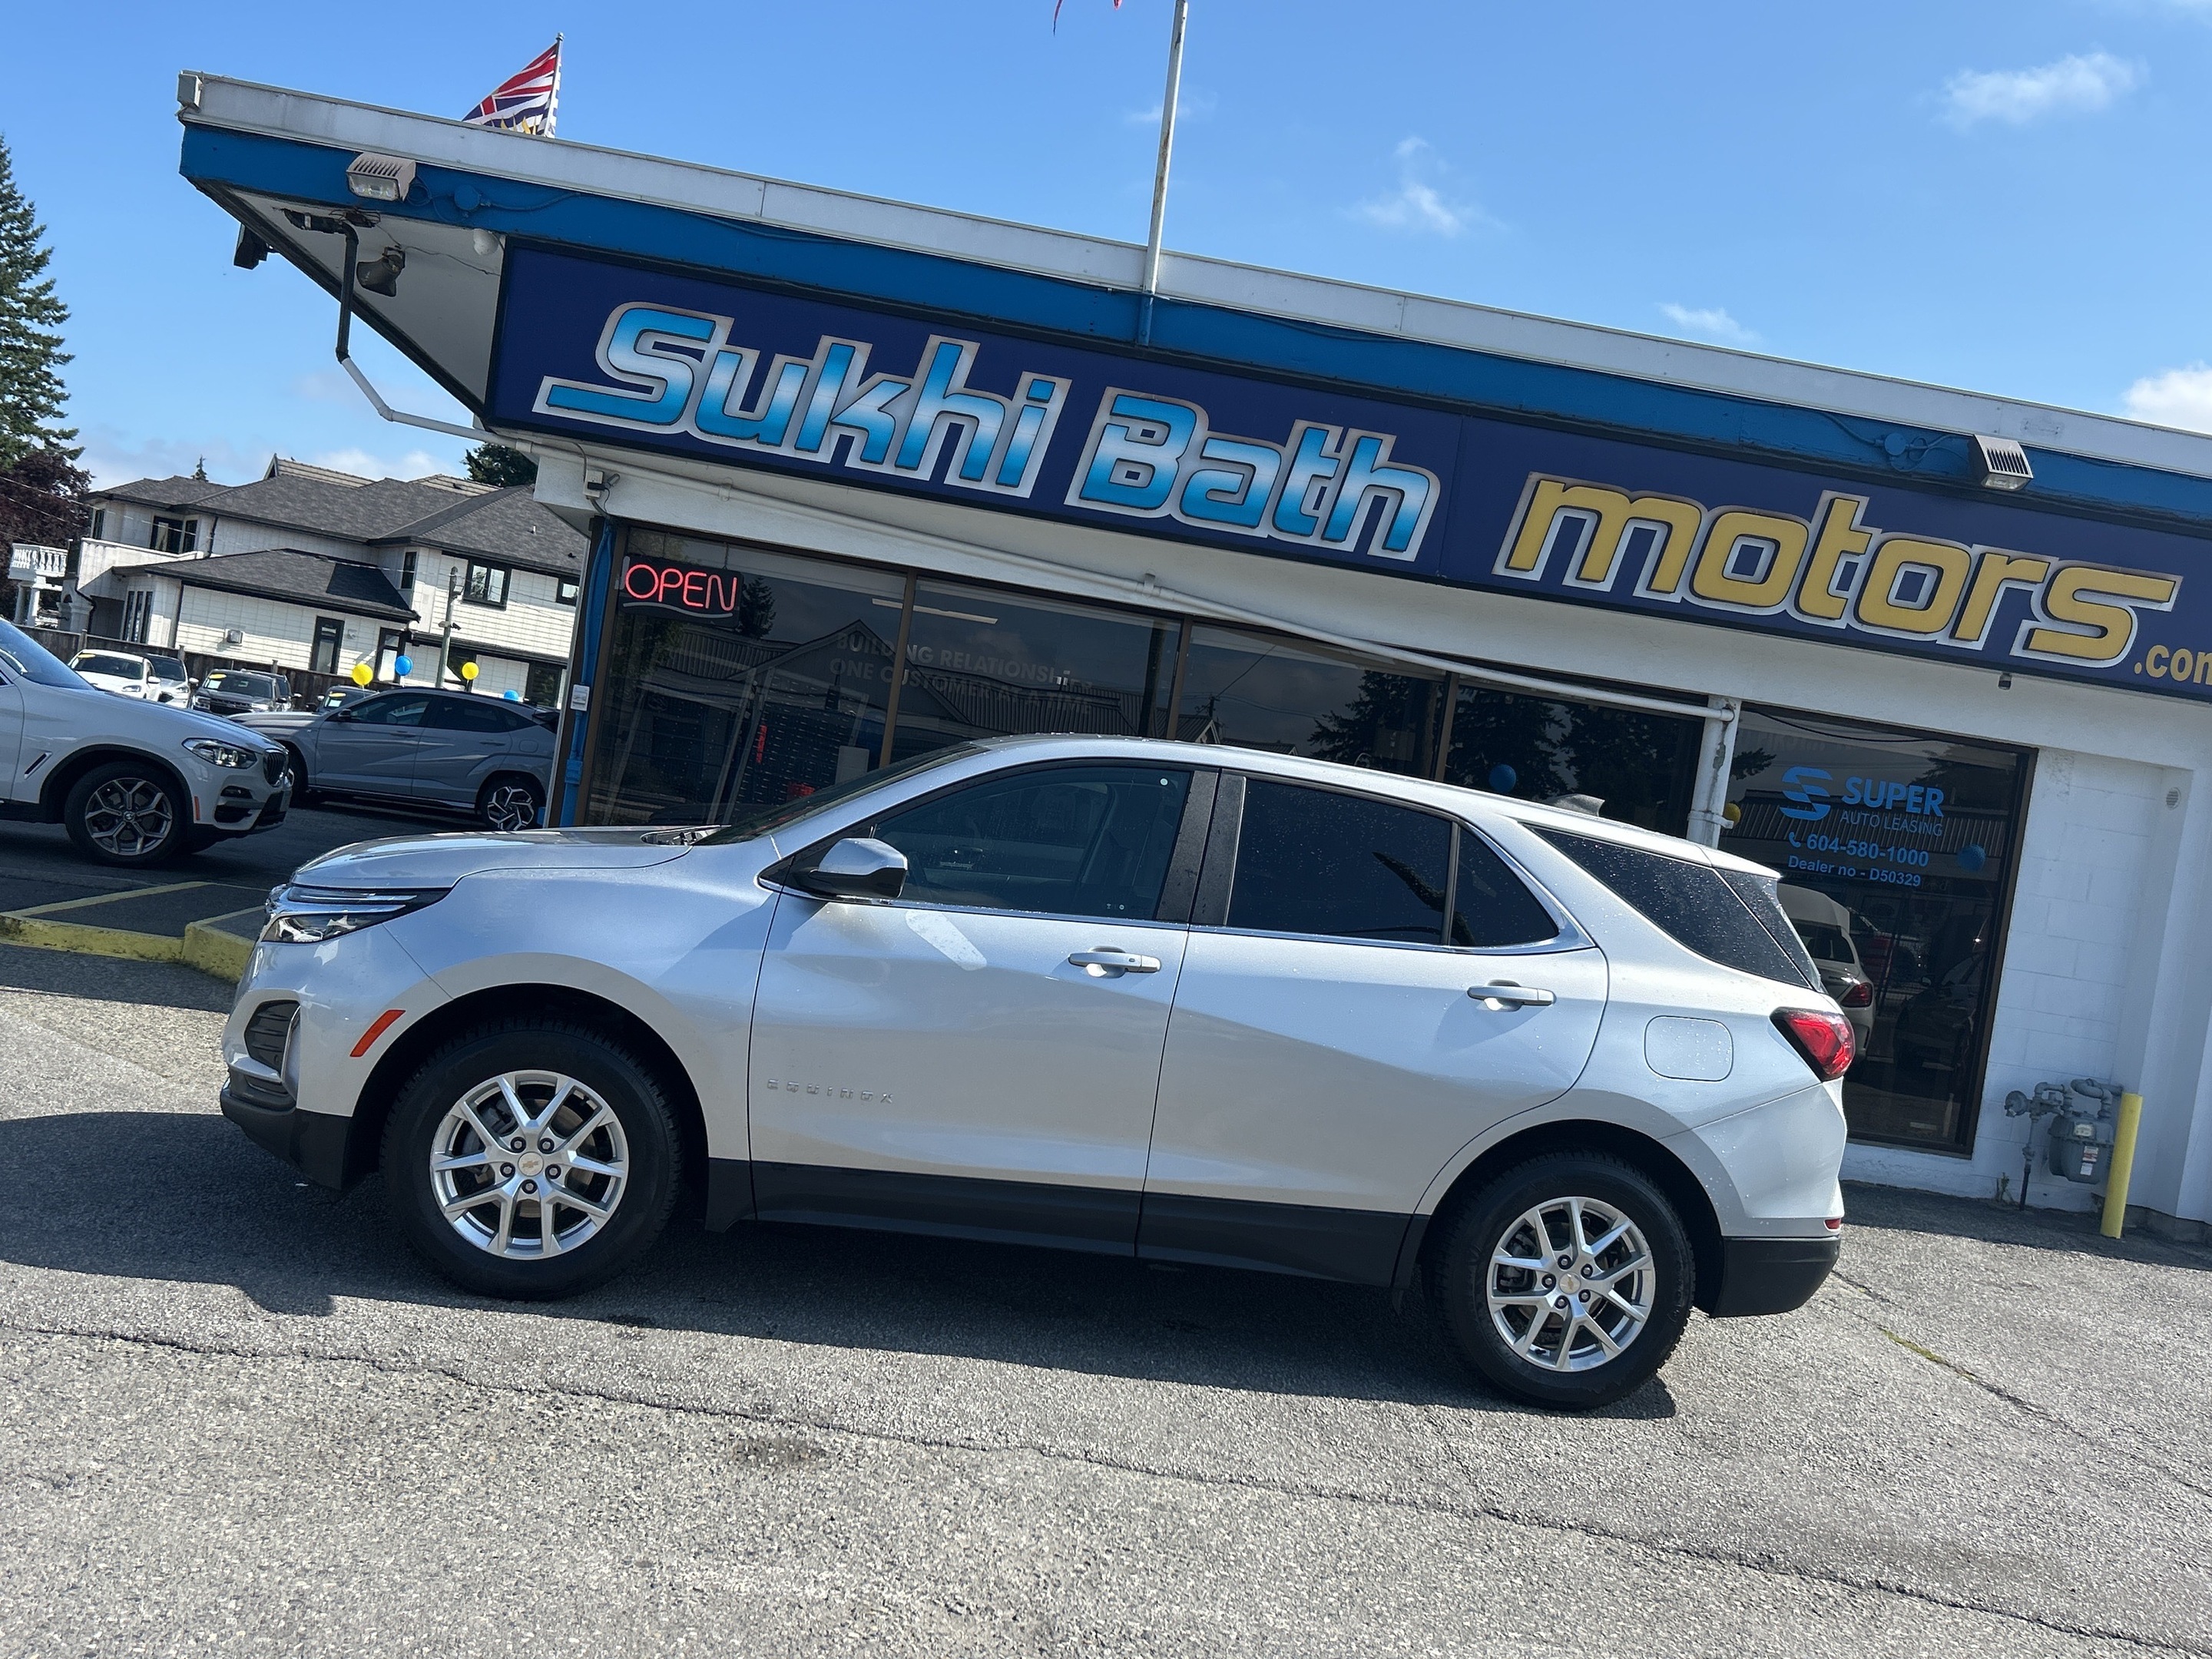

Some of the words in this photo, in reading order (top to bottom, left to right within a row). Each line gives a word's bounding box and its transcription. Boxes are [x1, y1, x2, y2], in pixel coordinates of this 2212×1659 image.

[532, 302, 1072, 498] Sukhi
[1064, 386, 1440, 561] Bath
[1492, 472, 2183, 667] motors
[624, 564, 737, 611] OPEN
[836, 632, 934, 664] BUILDNG
[830, 658, 874, 680] ONE
[1841, 776, 1944, 817] SUPER
[1839, 810, 1880, 828] AUTO
[1884, 817, 1942, 837] LEASING
[1806, 833, 1929, 867] 604-580-1000
[1788, 855, 1834, 873] Dealer
[1838, 864, 1856, 877] no
[1869, 867, 1921, 887] D50329
[767, 1078, 893, 1104] EQUINOX
